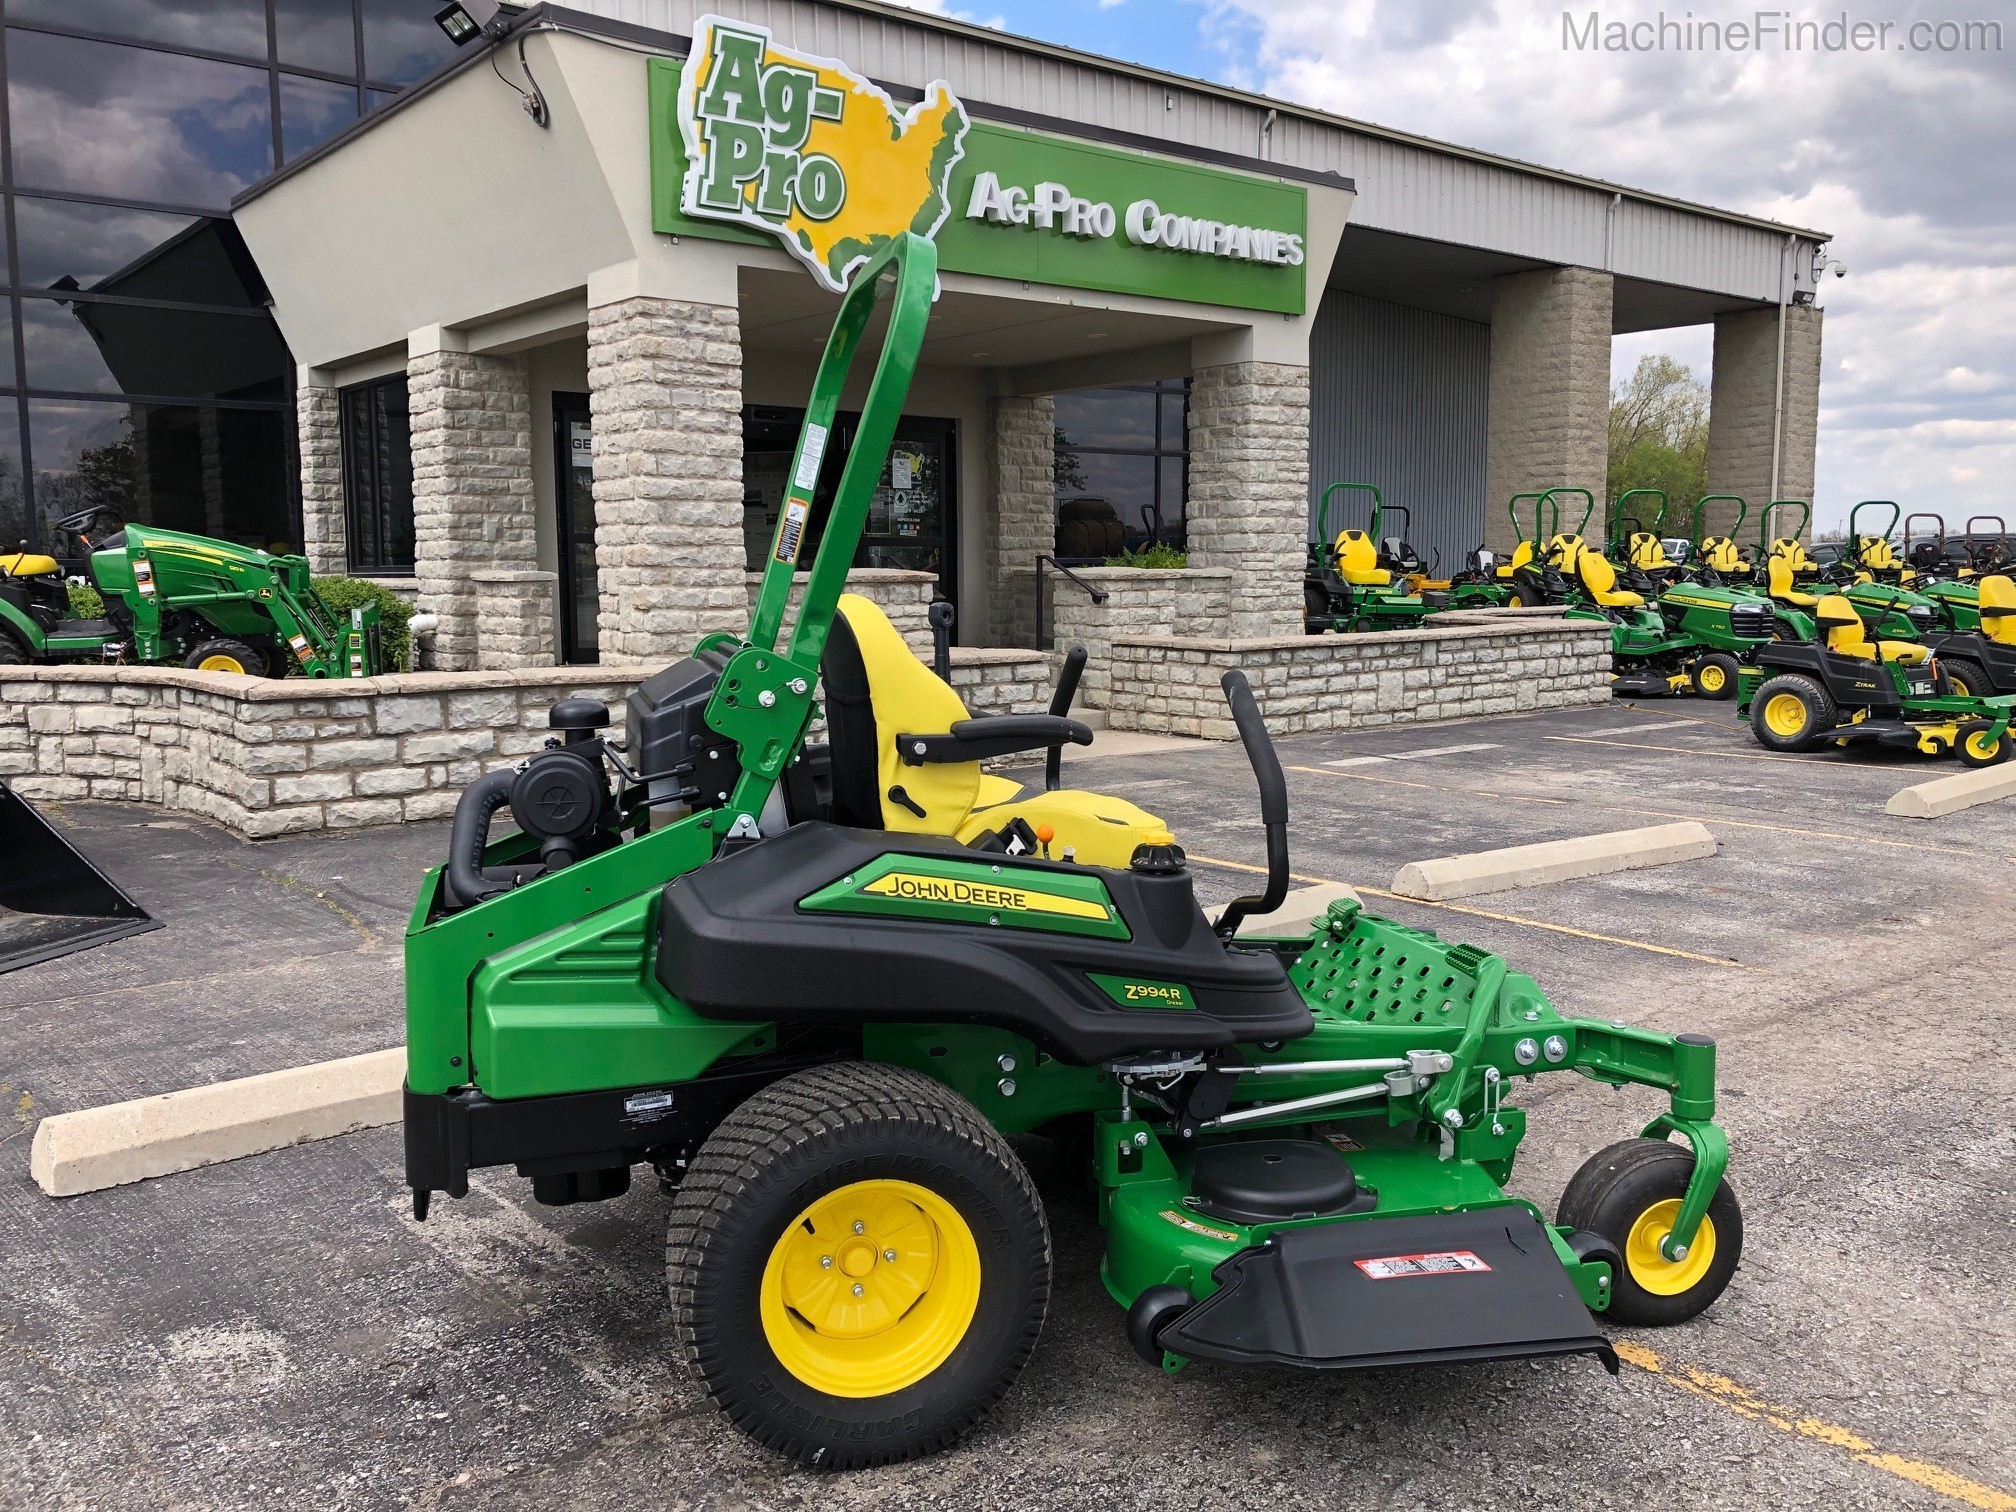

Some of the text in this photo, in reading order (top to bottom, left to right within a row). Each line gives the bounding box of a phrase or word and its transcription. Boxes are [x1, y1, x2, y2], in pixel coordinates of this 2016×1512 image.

[697, 28, 843, 152] Ag-
[699, 117, 846, 220] Pro
[888, 877, 1026, 907] JOHN DEERE
[1124, 985, 1181, 999] Z994R
[788, 1153, 1014, 1250] TURF MASTER
[748, 1371, 928, 1442] CARLISLE
